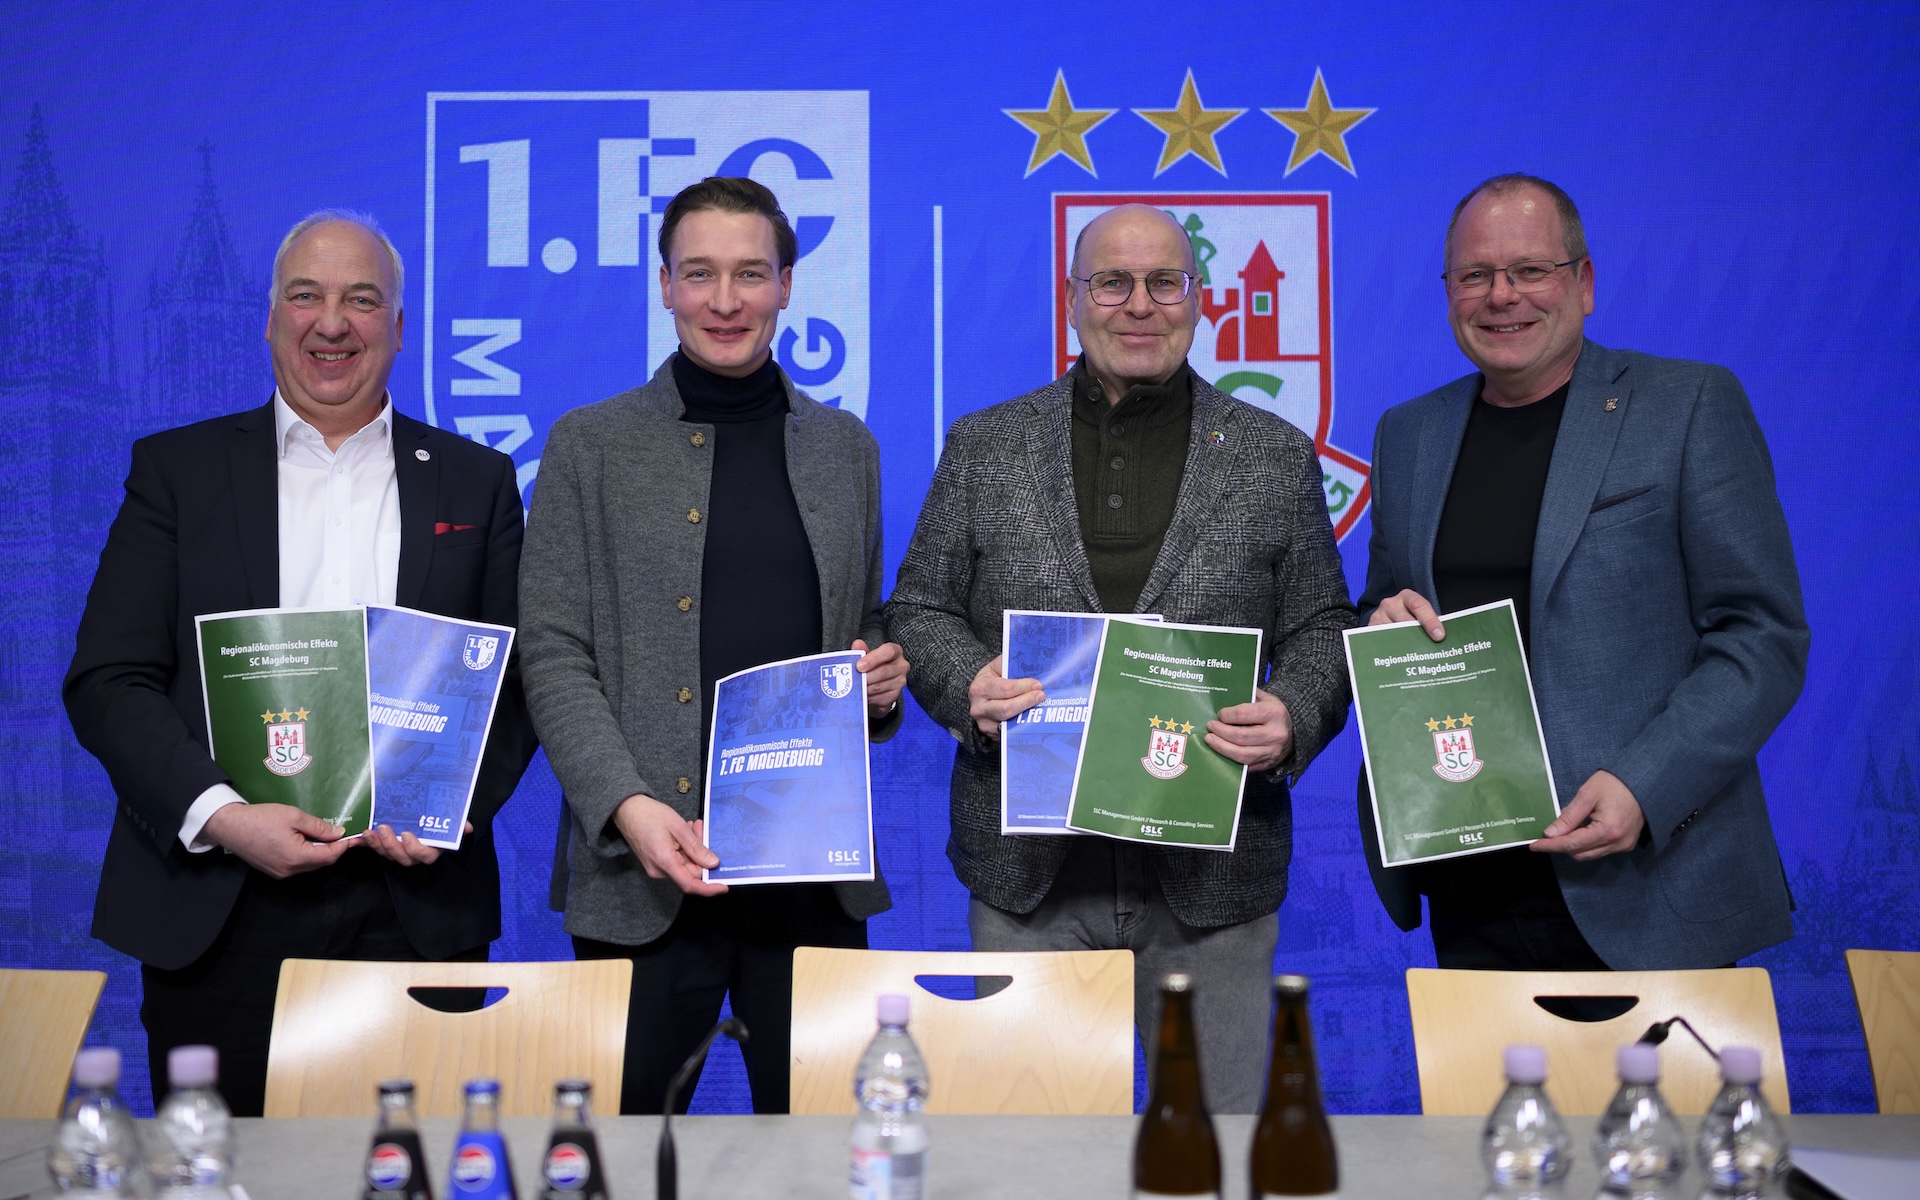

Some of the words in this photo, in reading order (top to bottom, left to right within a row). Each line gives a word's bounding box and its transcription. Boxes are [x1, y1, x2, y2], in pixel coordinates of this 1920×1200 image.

[221, 640, 308, 656] Regionalökonomische
[311, 639, 338, 649] Effekte
[1374, 648, 1463, 667] Regionalökonomische
[1463, 640, 1492, 653] Effekte
[249, 657, 260, 667] SC
[262, 655, 309, 667] Magdeburg
[465, 649, 493, 669] MAGDEBURG
[1124, 647, 1206, 668] Regionalökonomische
[1207, 658, 1232, 669] Effekte
[1149, 665, 1159, 674] SC
[1160, 667, 1204, 682] Magdeburg
[1406, 666, 1417, 676] SC
[1418, 661, 1466, 676] Magdeburg
[823, 679, 851, 698] MAGDEBURG
[371, 692, 416, 711] lökonomische
[416, 701, 440, 714] Effekte
[370, 705, 448, 733] MAGDEBURG
[1027, 708, 1043, 723] FC
[1044, 706, 1089, 723] MAGDE
[275, 745, 299, 763] SC
[721, 740, 788, 758] Regionalökonomische
[789, 738, 812, 749] Effekte
[267, 757, 308, 774] MAGDEBURG
[720, 759, 728, 776] 1.
[729, 756, 745, 774] FC
[746, 748, 824, 772] MAGDEBURG
[1145, 760, 1184, 777] MAGDEBURG
[1154, 751, 1177, 768] SC
[1445, 751, 1469, 769] SC
[1438, 762, 1480, 780] MAGDEBURG
[425, 816, 451, 829] SLC
[1093, 807, 1102, 815] SLC
[1101, 809, 1131, 820] Management
[1149, 817, 1168, 825] Research
[1173, 820, 1196, 828] Consulting
[1145, 826, 1163, 834] SLC
[1413, 829, 1444, 840] Management
[1465, 823, 1485, 831] Research
[1490, 817, 1516, 827] Consulting
[1516, 816, 1535, 824] Services
[1465, 832, 1484, 842] SLC
[834, 850, 860, 861] SLC
